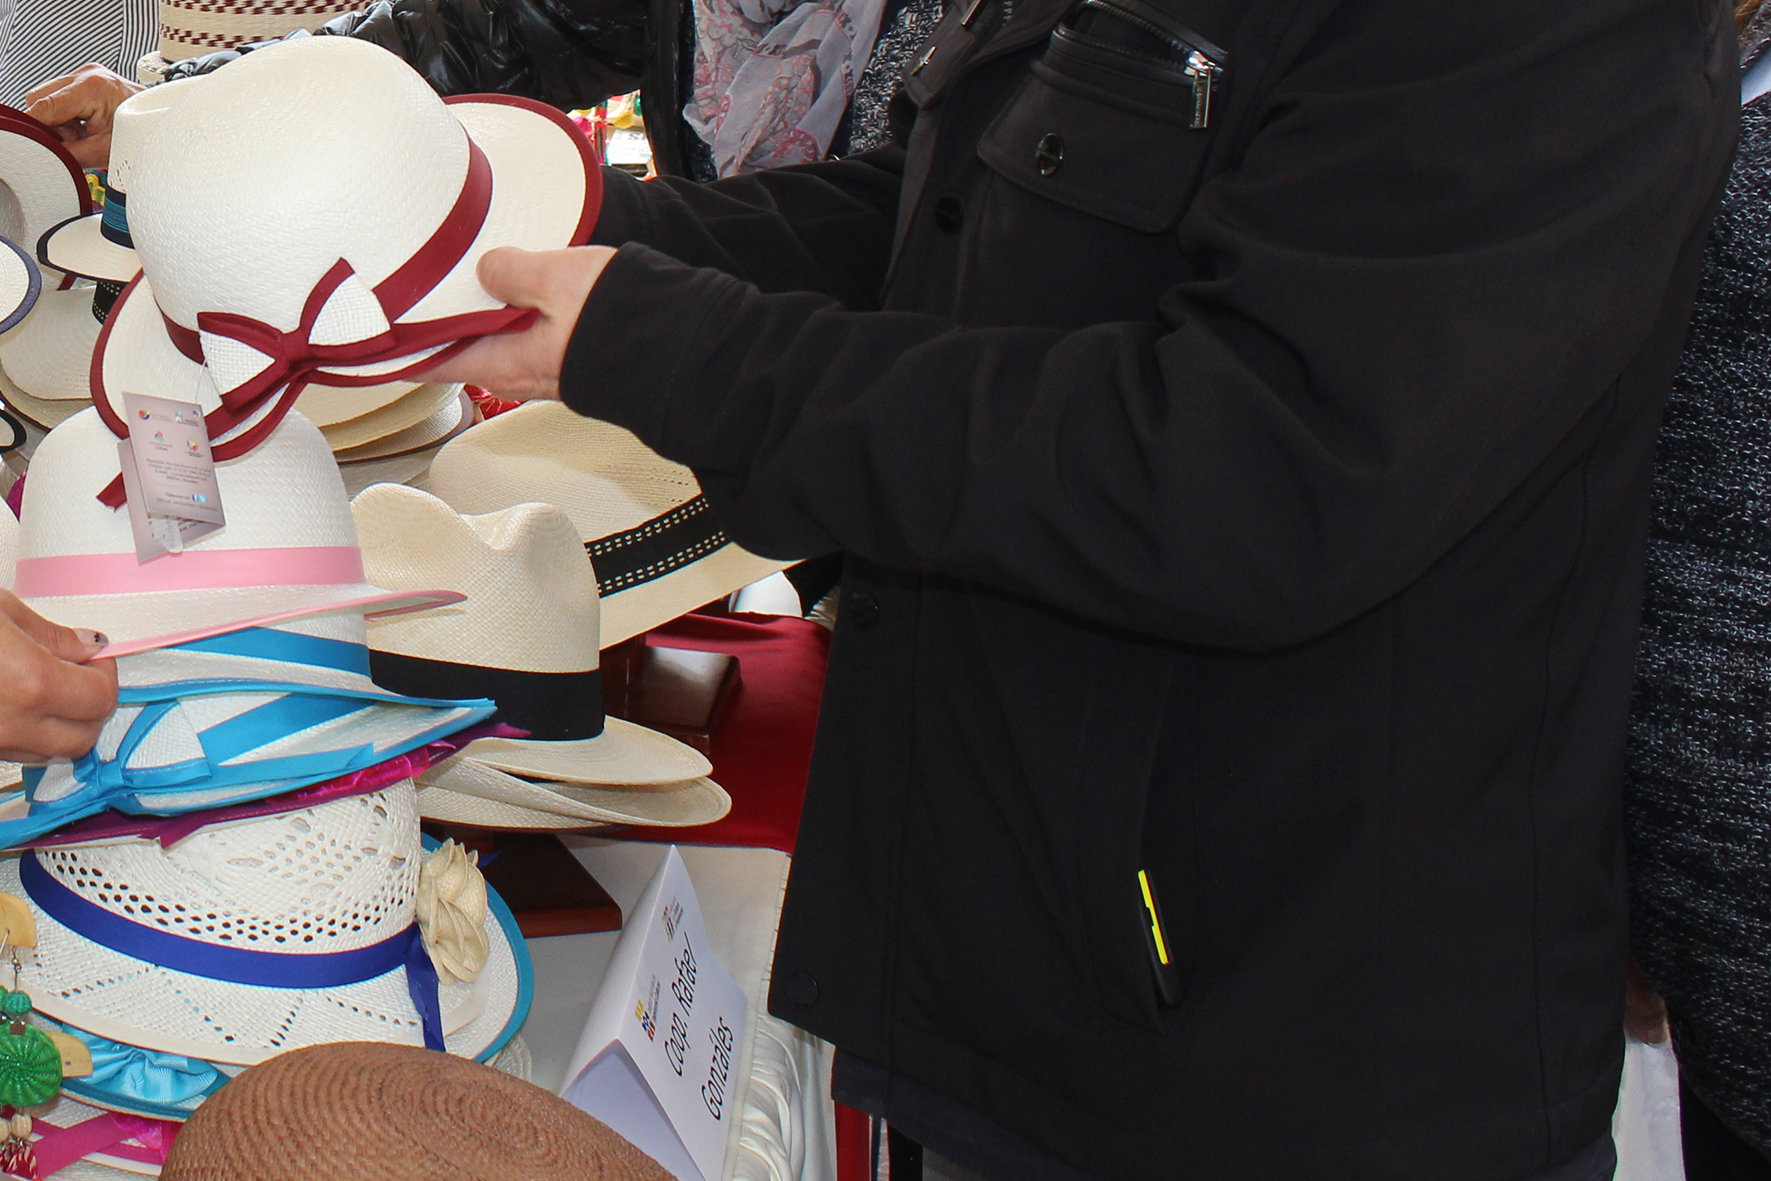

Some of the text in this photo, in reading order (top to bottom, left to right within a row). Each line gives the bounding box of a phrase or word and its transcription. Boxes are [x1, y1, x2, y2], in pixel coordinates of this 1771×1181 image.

[671, 931, 697, 1017] Rafael
[665, 1011, 690, 1077] Coop.
[701, 1016, 734, 1121] Gonzáles
